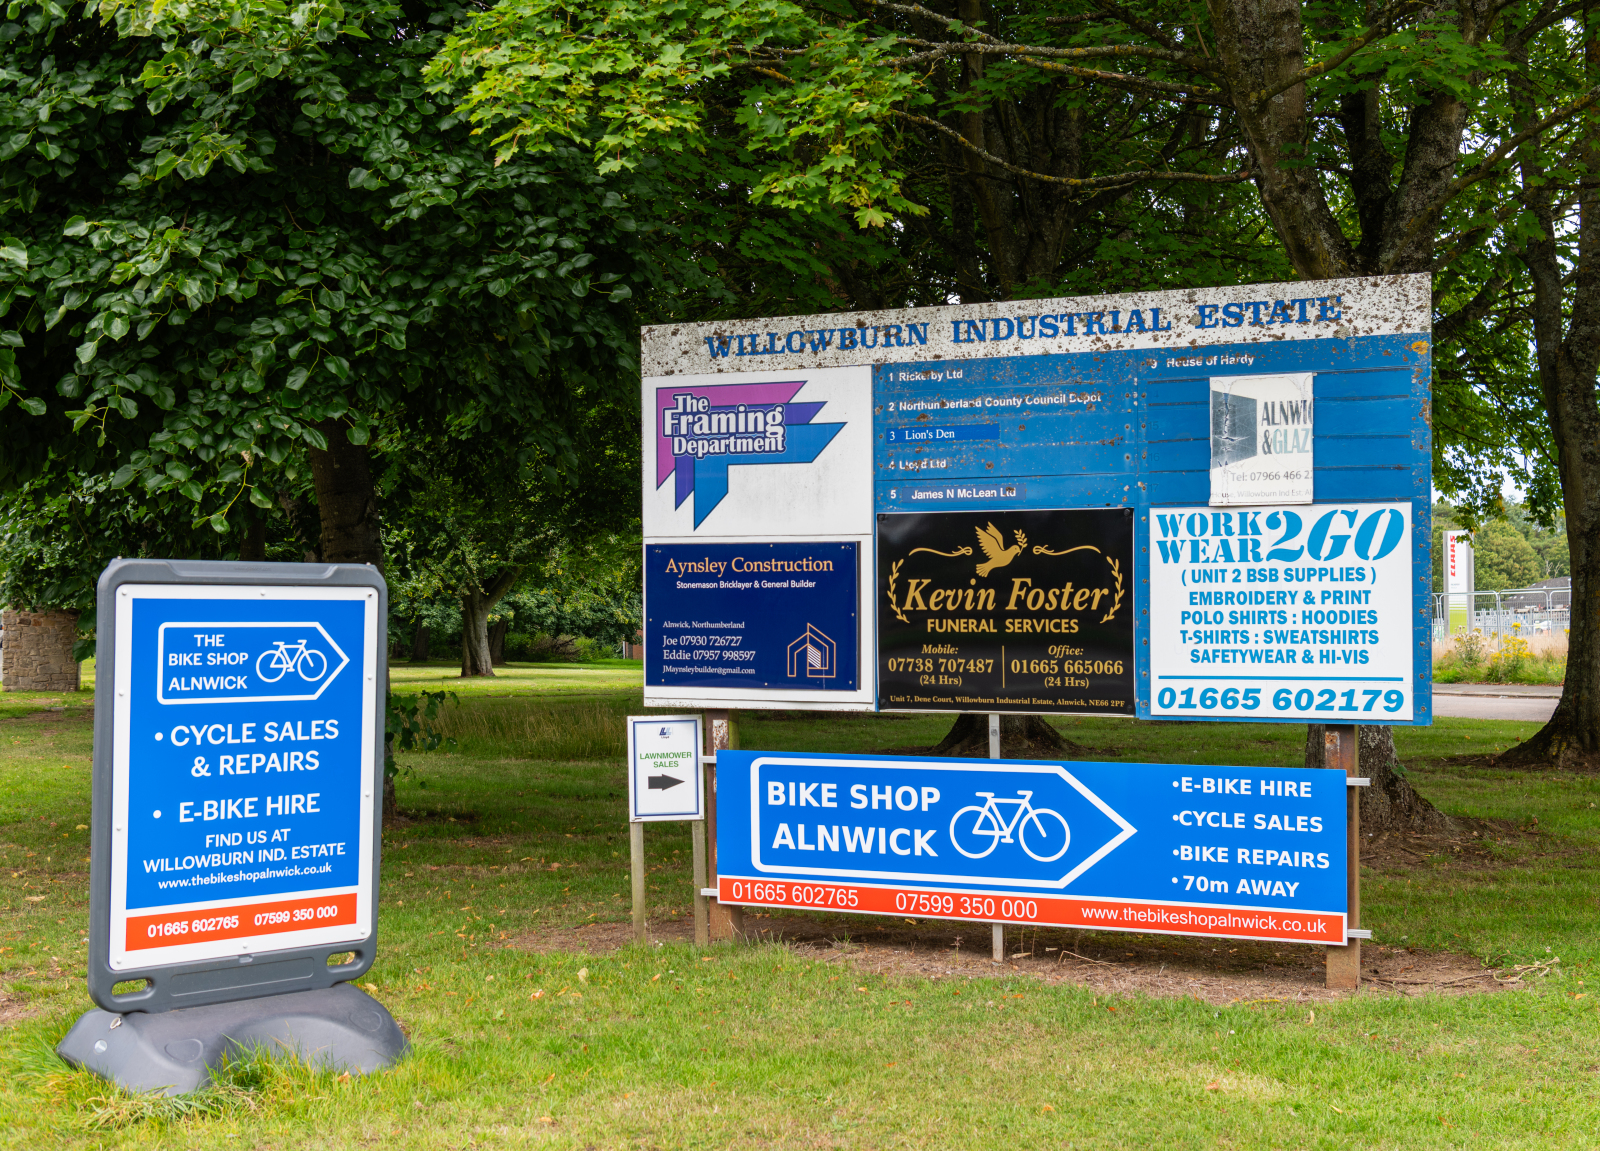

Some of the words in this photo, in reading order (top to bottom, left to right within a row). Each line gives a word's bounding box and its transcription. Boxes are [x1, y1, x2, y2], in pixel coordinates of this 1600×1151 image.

[704, 322, 930, 358] WILLOWBURN
[950, 308, 1171, 344] INDUSTRIAL
[1194, 296, 1342, 329] ESTATE
[1166, 357, 1203, 368] House
[1206, 356, 1218, 366] of
[1220, 354, 1254, 367] Hardy
[889, 372, 894, 382] 1
[946, 369, 963, 380] Ltd
[674, 394, 709, 413] The
[888, 402, 895, 412] 2
[985, 396, 1023, 408] County
[1025, 394, 1066, 405] Council
[664, 405, 784, 438] Framing
[889, 431, 896, 441] 3
[905, 430, 933, 440] Lion's
[936, 429, 955, 439] Den
[673, 435, 785, 458] Department
[889, 460, 895, 470] 4
[930, 459, 946, 469] Ltd
[1230, 472, 1247, 482] Tel:
[1250, 471, 1281, 481] 07966
[1283, 470, 1302, 480] 466
[890, 490, 897, 499] 5
[911, 490, 944, 500] James
[946, 489, 955, 498] N
[957, 488, 997, 498] McLean
[1000, 487, 1016, 498] Ltd
[1237, 490, 1277, 498] Willowburn
[1279, 489, 1290, 497] Ind
[1156, 511, 1263, 538] WORK
[1265, 508, 1405, 563] 2GO
[1156, 538, 1264, 564] WEAR
[665, 557, 728, 578] Aynsley
[731, 556, 834, 573] Construction
[1232, 568, 1242, 583] 2
[1246, 568, 1280, 583] BSB
[1283, 567, 1366, 582] SUPPLIES
[676, 580, 718, 589] Stonemason
[720, 580, 752, 591] Bricklayer
[753, 580, 760, 588] &
[761, 580, 789, 588] General
[791, 579, 816, 588] Builder
[902, 578, 997, 611] Kevin
[1005, 577, 1109, 611] Foster
[1189, 590, 1299, 606] EMBROIDERY
[1302, 590, 1316, 605] &
[1320, 589, 1371, 605] PRINT
[662, 621, 691, 629] Alnwick,
[692, 621, 745, 629] Northumberland
[1181, 610, 1224, 625] POLO
[1228, 610, 1288, 625] SHIRTS
[1301, 610, 1378, 625] HOODIES
[927, 618, 998, 633] FUNERAL
[1005, 618, 1079, 634] SERVICES
[194, 634, 225, 647] THE
[662, 635, 678, 647] Joe
[680, 635, 708, 646] 07930
[709, 636, 743, 646] 726727
[1180, 630, 1250, 645] T-SHIRTS
[1263, 630, 1379, 645] SWEATSHIRTS
[663, 649, 691, 660] Eddie
[693, 650, 721, 660] 07957
[722, 650, 756, 661] 998597
[921, 644, 959, 655] Mobile:
[1048, 645, 1084, 659] Office:
[1190, 649, 1297, 664] SAFETYWEAR
[1301, 649, 1315, 664] &
[1319, 649, 1370, 665] HI-VIS
[168, 653, 203, 666] BIKE
[206, 652, 249, 665] SHOP
[888, 658, 934, 674] 07738
[938, 659, 994, 674] 707487
[1011, 659, 1059, 675] 01665
[1064, 660, 1124, 675] 665066
[662, 665, 756, 676] JMaynsleybuilder@gmail.com
[168, 676, 248, 691] ALNWICK
[919, 674, 937, 687] (24
[939, 675, 963, 687] Hrs)
[1044, 676, 1062, 689] (24
[1064, 676, 1090, 689] Hrs)
[890, 695, 905, 703] Unit
[906, 696, 913, 705] 7,
[914, 696, 932, 704] Dene
[933, 696, 954, 706] Court,
[955, 696, 995, 705] Willowburn
[996, 697, 1031, 706] Industrial
[1032, 697, 1055, 707] Estate,
[1056, 698, 1088, 708] Alnwick,
[1088, 699, 1109, 708] NE66
[1111, 699, 1126, 708] 2PF
[1157, 687, 1262, 711] 01665
[1272, 688, 1405, 713] 602179
[170, 722, 257, 747] CYCLE
[263, 719, 340, 743] SALES
[191, 756, 212, 778] &
[219, 750, 320, 776] REPAIRS
[639, 752, 693, 760] LAWNMOWER
[653, 760, 679, 768] SALES
[1181, 777, 1252, 795] E-BIKE
[1260, 780, 1312, 798] HIRE
[767, 781, 838, 808] BIKE
[850, 784, 941, 811] SHOP
[179, 797, 259, 823] E-BIKE
[266, 792, 321, 816] HIRE
[1178, 810, 1246, 829] CYCLE
[1253, 813, 1323, 832] SALES
[205, 832, 243, 848] FIND
[247, 830, 268, 845] US
[271, 828, 291, 843] AT
[772, 823, 938, 857] ALNWICK
[143, 850, 254, 873] WILLOWBURN
[258, 847, 288, 863] IND.
[291, 842, 346, 860] ESTATE
[1180, 845, 1229, 863] BIKE
[1237, 848, 1330, 869] REPAIRS
[158, 862, 332, 889] www.thebikeshopalnwick.co.uk
[1183, 875, 1229, 893] 70m
[1236, 878, 1300, 897] AWAY
[732, 881, 786, 902] 01665
[791, 885, 858, 907] 602765
[895, 893, 954, 914] 07599
[960, 896, 995, 916] 350
[1001, 899, 1038, 919] 000
[147, 920, 189, 938] 01665
[191, 915, 239, 933] 602765
[254, 910, 291, 926] 07599
[292, 908, 315, 922] 350
[316, 905, 338, 919] 000
[1081, 907, 1327, 934] www.thebikeshopalnwick.co.uk
